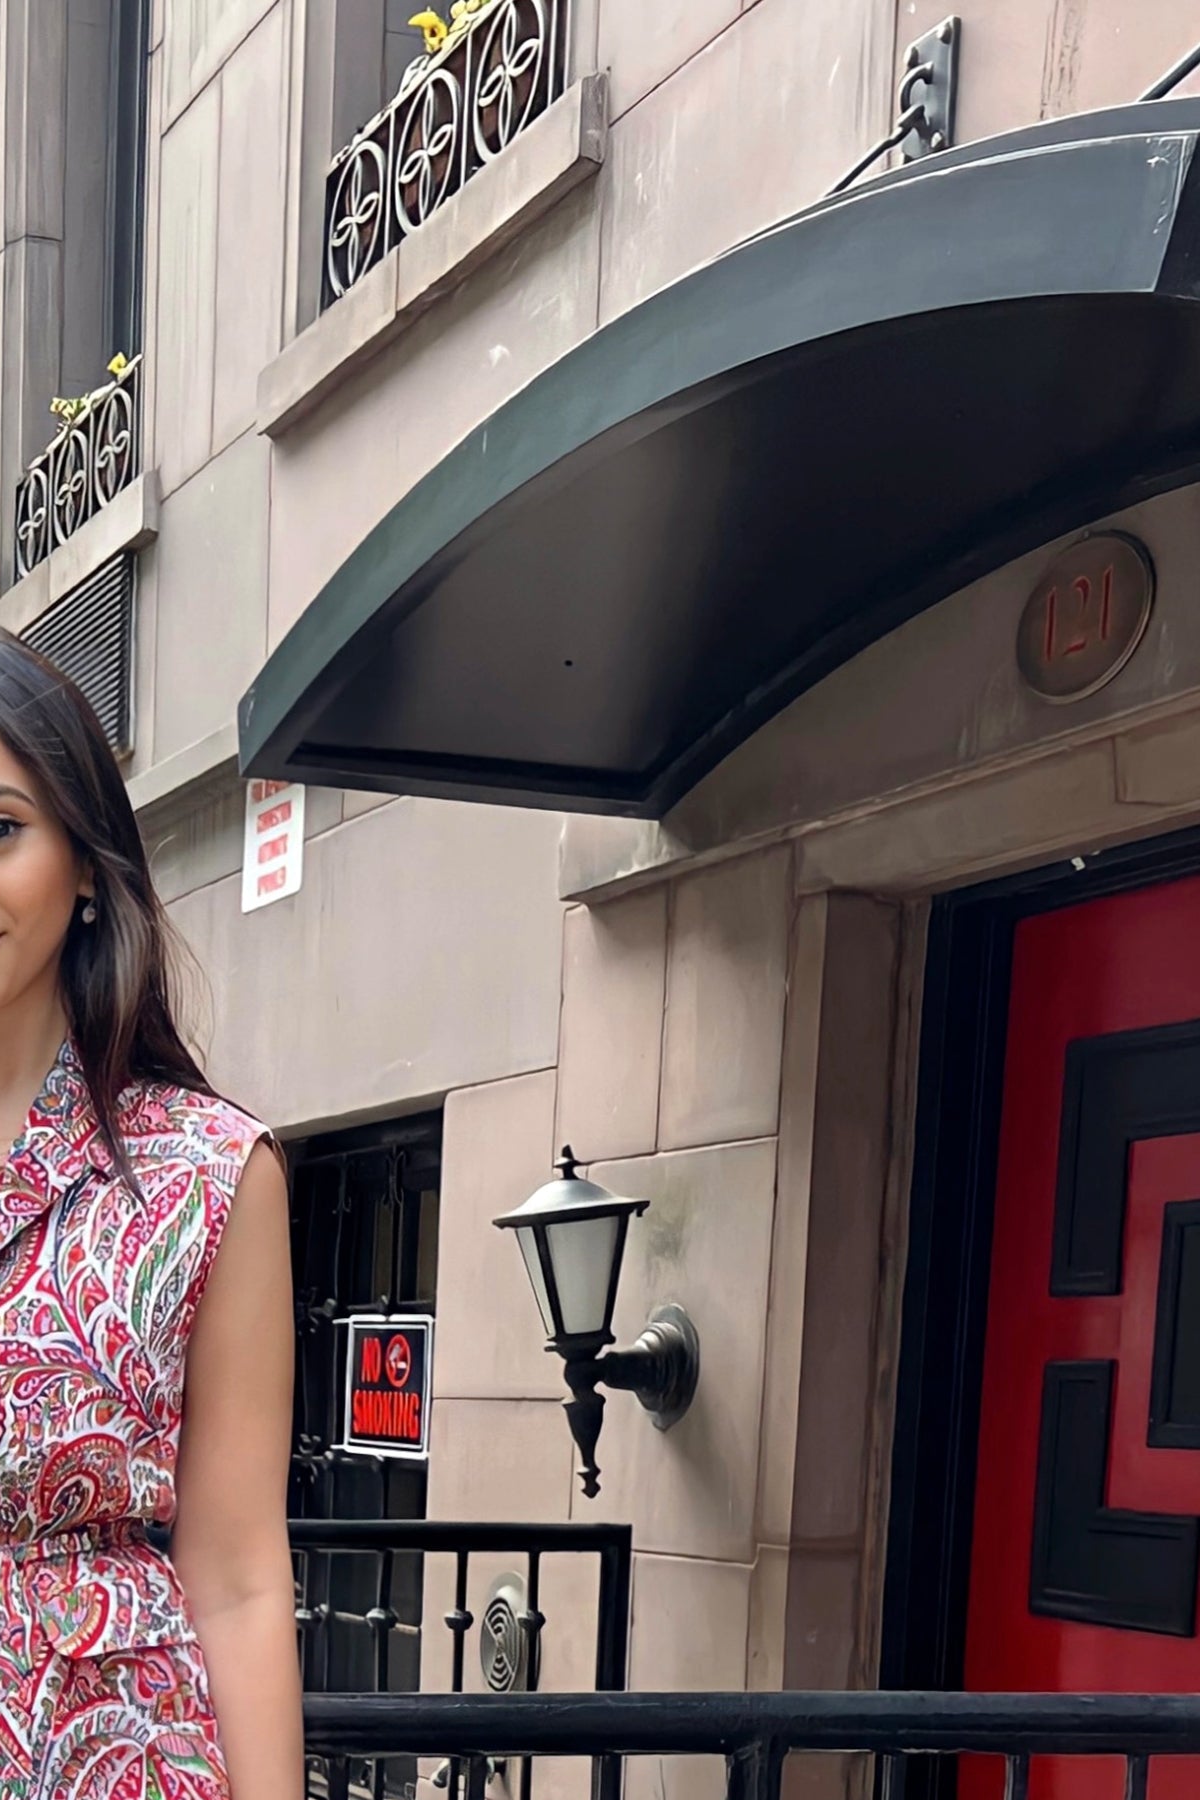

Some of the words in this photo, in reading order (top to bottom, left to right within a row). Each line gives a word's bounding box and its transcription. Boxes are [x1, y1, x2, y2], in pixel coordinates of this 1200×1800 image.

[1043, 563, 1114, 666] 121
[361, 1336, 382, 1384] NO
[353, 1388, 420, 1439] SMOKING
